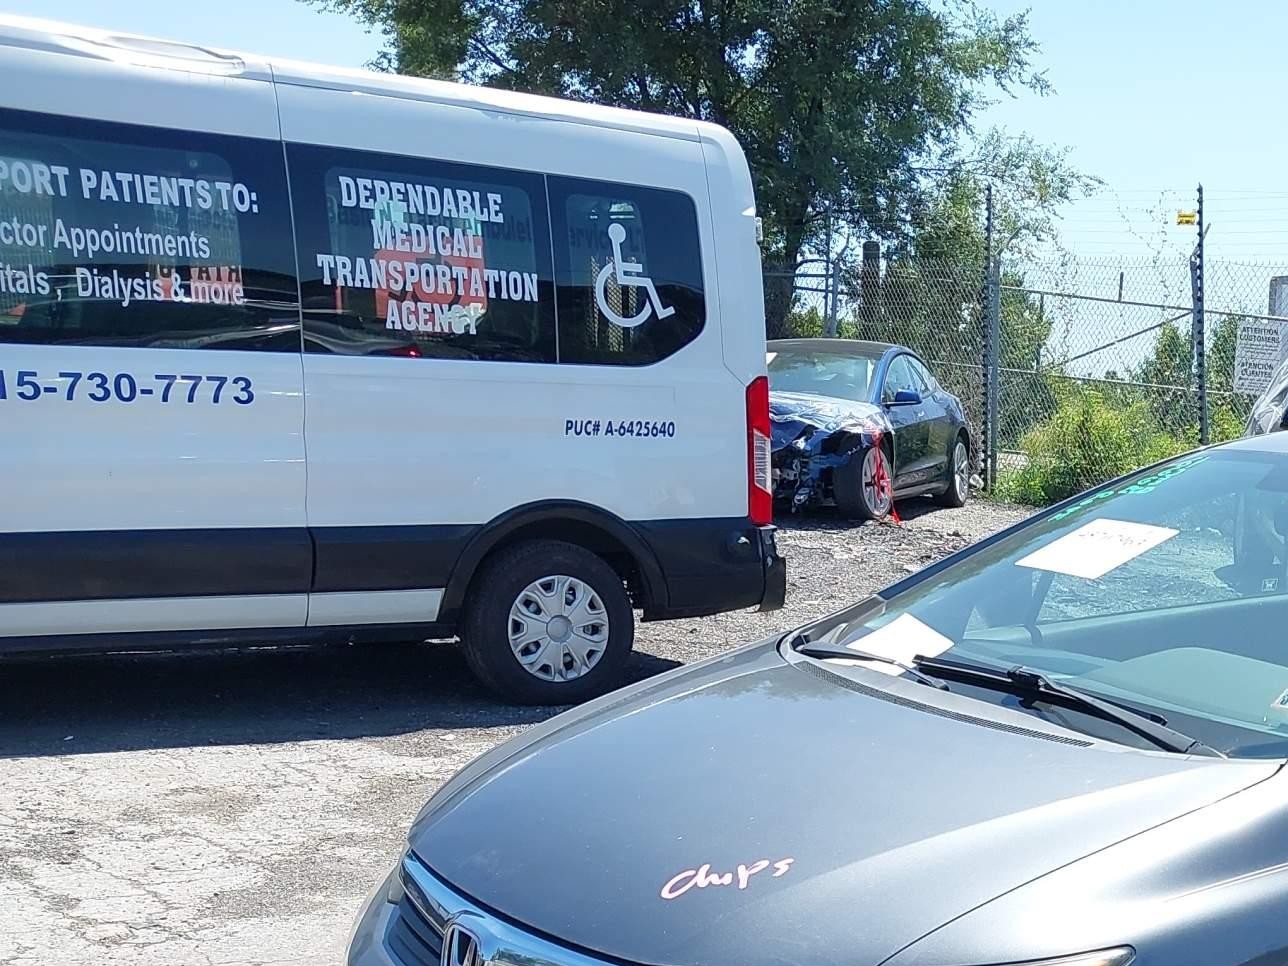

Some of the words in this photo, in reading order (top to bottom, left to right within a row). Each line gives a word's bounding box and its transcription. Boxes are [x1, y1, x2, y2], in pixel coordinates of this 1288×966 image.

[80, 168, 212, 209] PATIENTS
[214, 181, 259, 213] TO:
[338, 175, 504, 224] DEPENDABLE
[0, 215, 47, 248] ctor
[53, 218, 211, 258] Appointments
[371, 218, 482, 259] MEDICAL
[76, 267, 163, 307] Dialysis
[170, 272, 187, 302] &
[191, 279, 244, 306] more
[317, 253, 539, 303] TRANSPORTATION
[385, 299, 484, 335] AGENCY
[565, 419, 600, 436] PUC#
[604, 420, 676, 438] A-6425640
